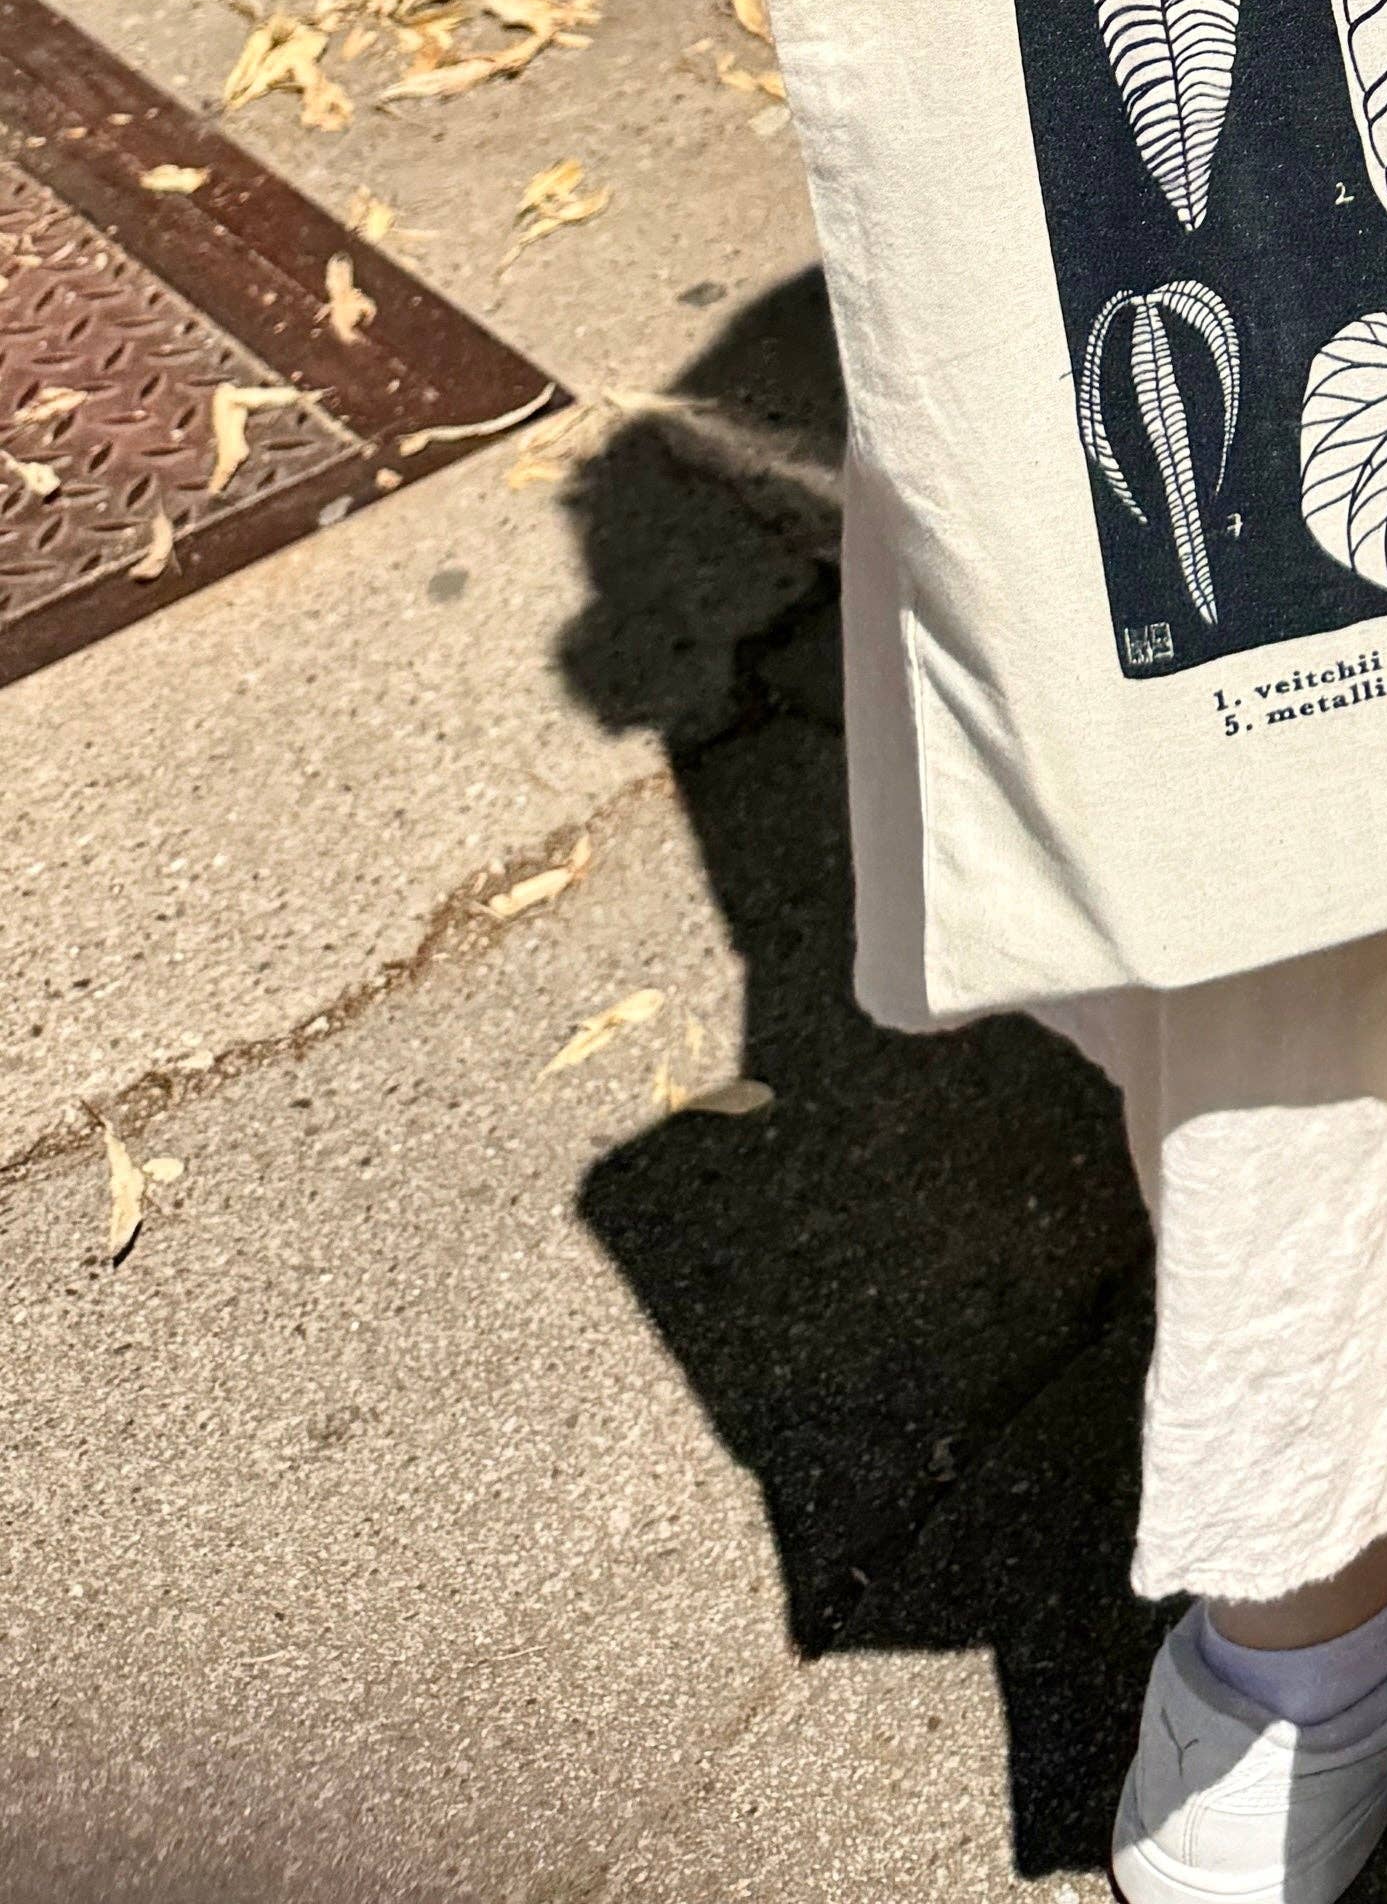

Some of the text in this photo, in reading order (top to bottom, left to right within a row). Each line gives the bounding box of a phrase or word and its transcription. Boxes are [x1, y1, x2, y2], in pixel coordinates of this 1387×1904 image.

[1334, 181, 1356, 206] 2
[1213, 690, 1243, 713] 1.
[1254, 650, 1384, 702] veitchii
[1222, 713, 1254, 738] 5.
